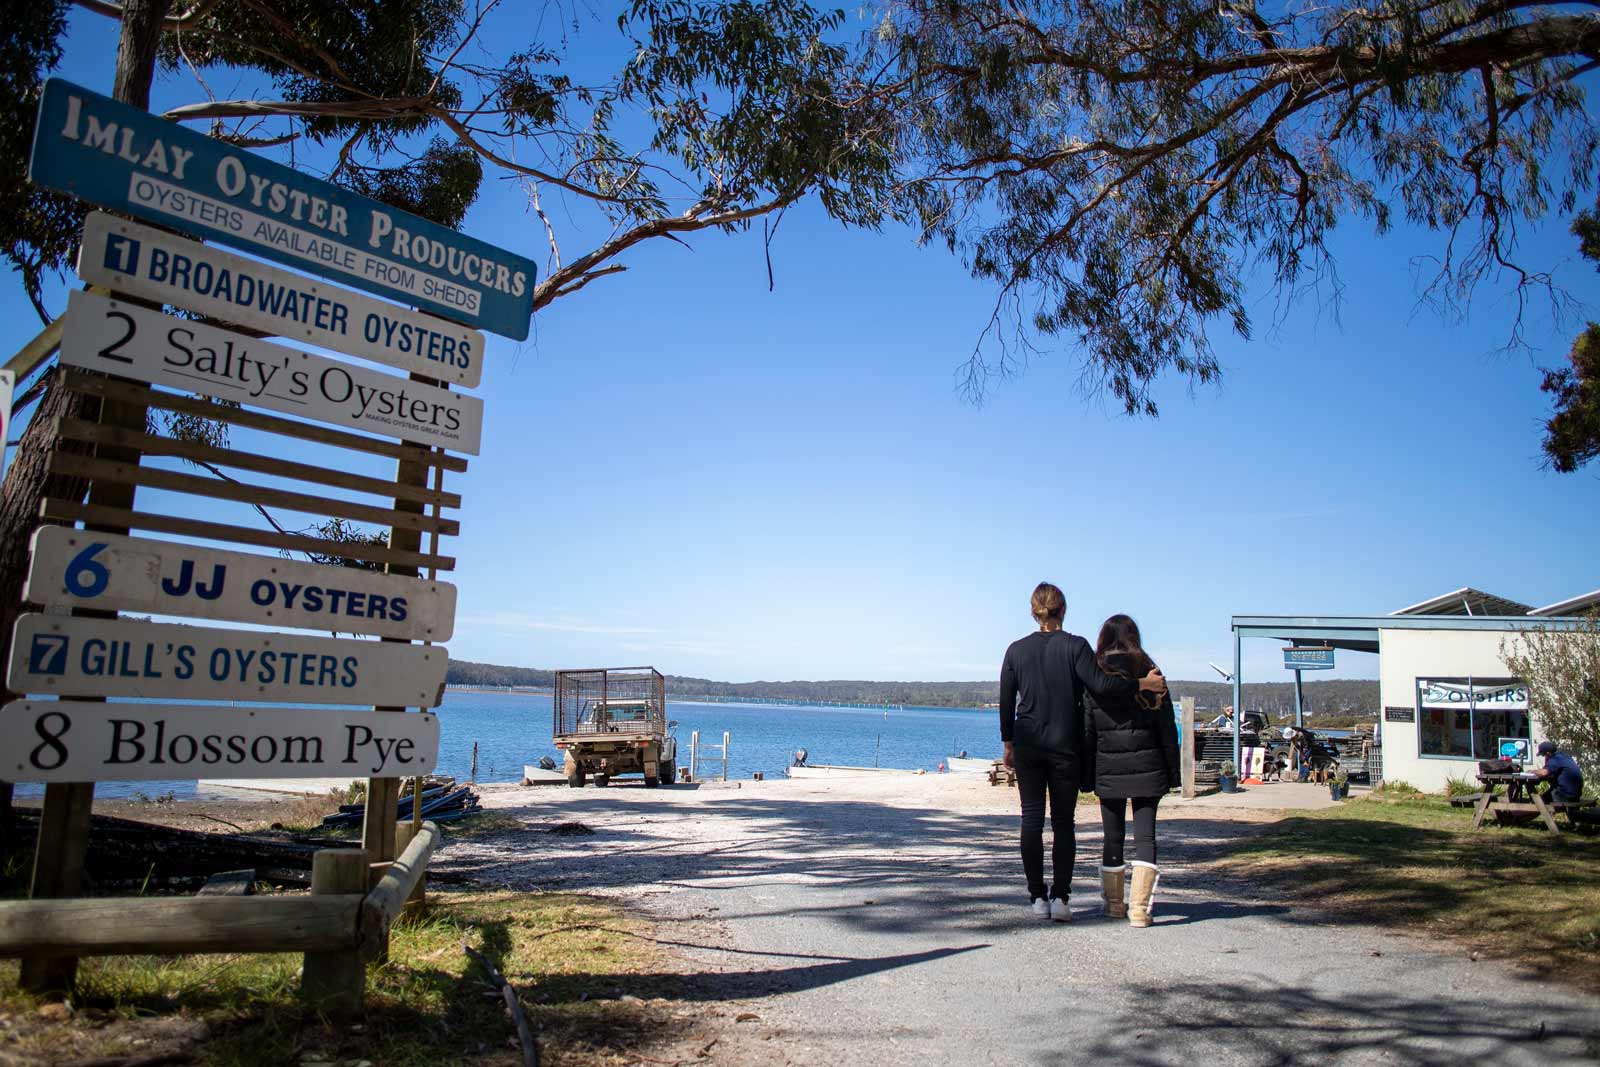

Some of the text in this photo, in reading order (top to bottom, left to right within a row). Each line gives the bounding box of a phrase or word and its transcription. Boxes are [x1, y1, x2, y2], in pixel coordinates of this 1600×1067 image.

[135, 180, 478, 312] OYSTERS AVAILABLE FROM SHEDS
[111, 239, 471, 370] 1 BROADWATER OYSTERS
[98, 311, 461, 430] 2 Salty's Oysters
[365, 413, 460, 440] MAKING OYSTERS GREAT AGAIN
[64, 542, 408, 622] 6 JJ OYSTERS
[35, 636, 358, 688] 7 GILL'S OYSTERS
[30, 712, 426, 774] 8 Blossom Pye.
